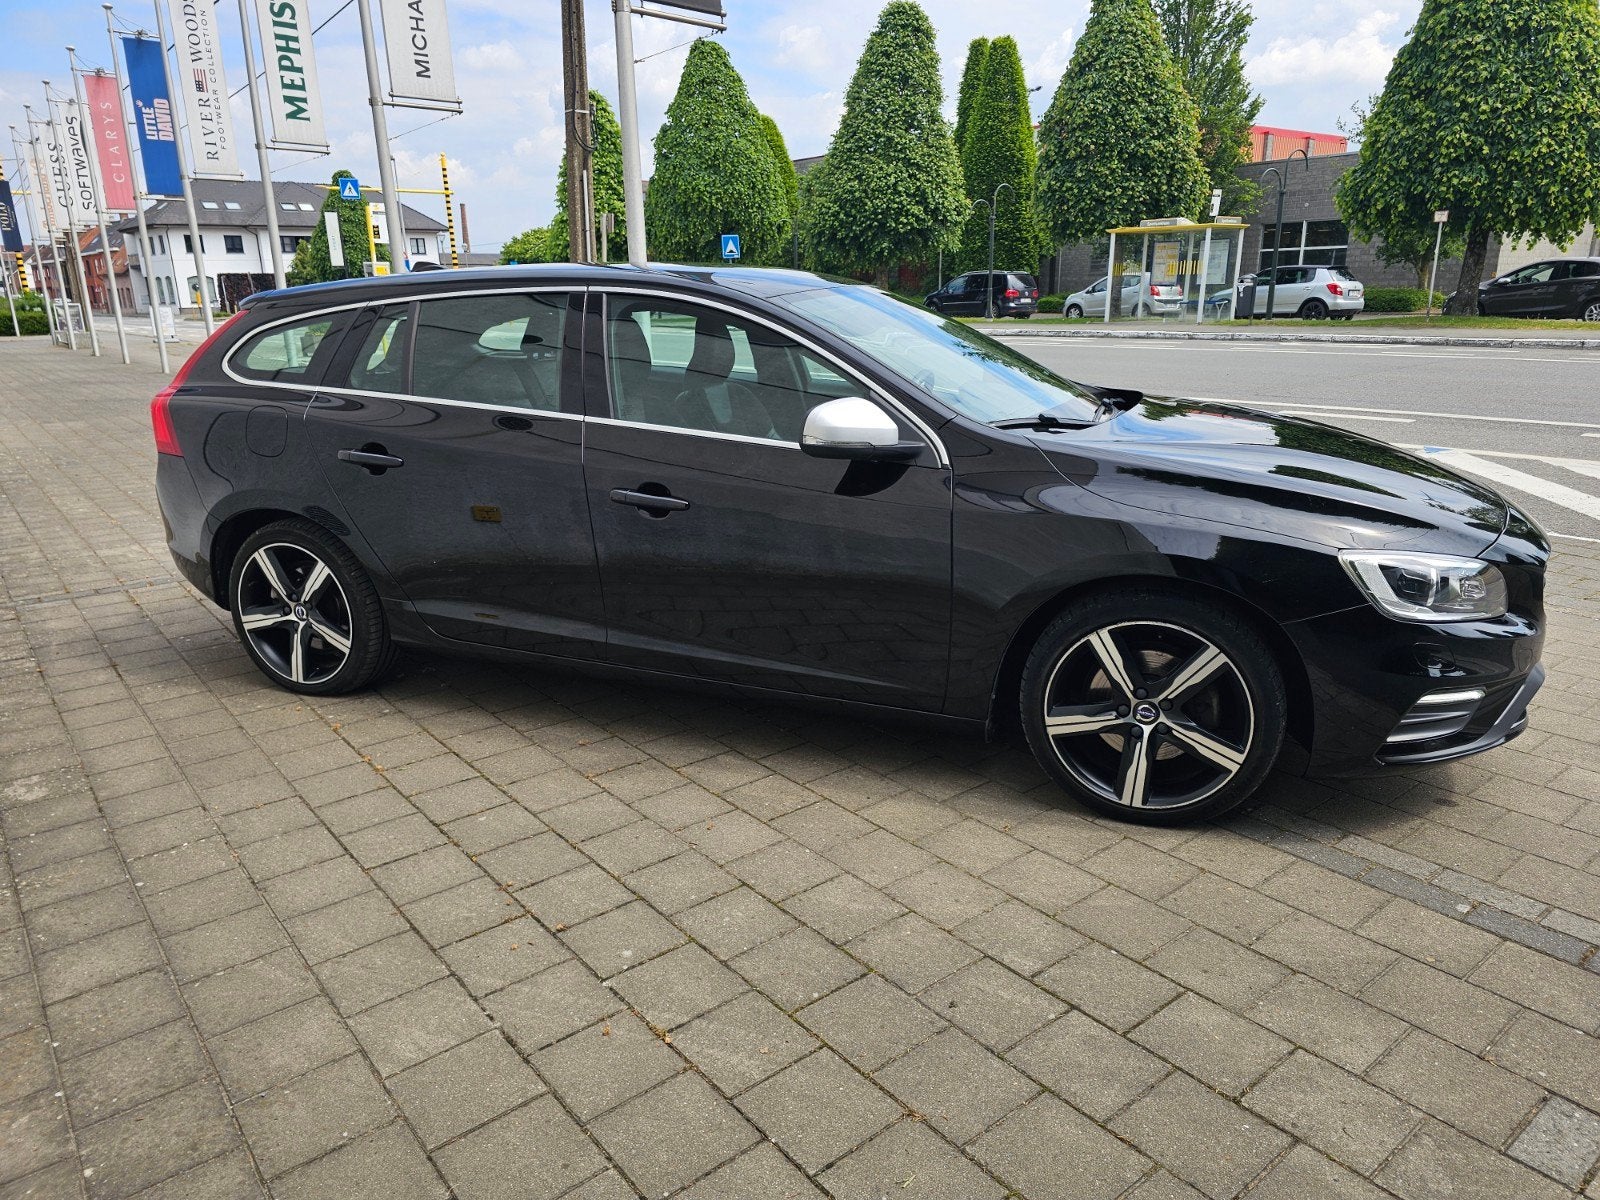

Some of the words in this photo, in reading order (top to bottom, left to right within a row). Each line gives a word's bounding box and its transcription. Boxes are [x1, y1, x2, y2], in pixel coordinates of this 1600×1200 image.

[182, 0, 204, 63] WOOD
[200, 9, 217, 83] COLLECTION
[269, 0, 311, 122] MEPHIS
[407, 0, 431, 78] MICHA
[100, 102, 125, 183] CLARYS
[142, 106, 159, 140] LITTLE
[153, 98, 175, 142] DAVID
[197, 97, 220, 161] RIVER
[212, 89, 227, 150] FOOTWEAR
